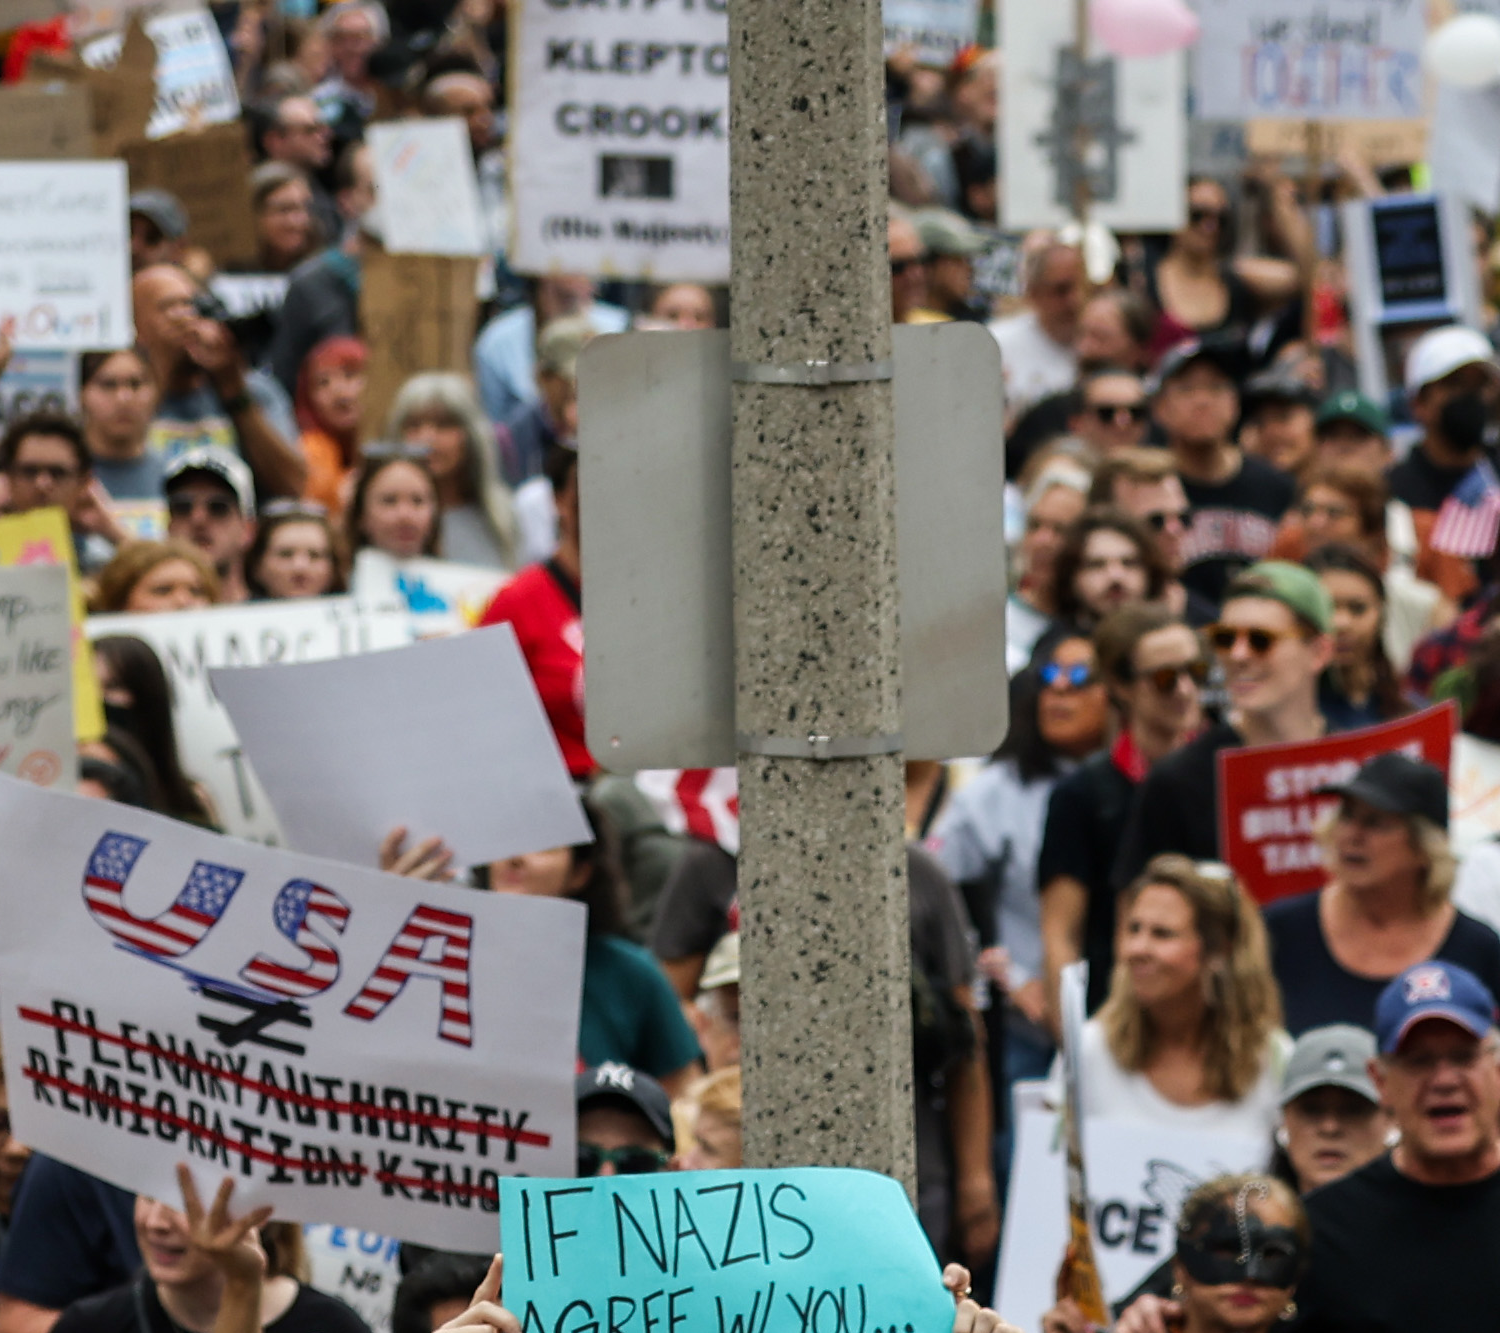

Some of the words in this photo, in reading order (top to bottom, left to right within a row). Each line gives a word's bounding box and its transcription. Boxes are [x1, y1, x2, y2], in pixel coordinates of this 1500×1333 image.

[13, 642, 64, 680] like
[81, 831, 476, 1048] USA
[48, 998, 250, 1108] PLENARY
[256, 1058, 532, 1165] AUTHORITY
[376, 1148, 525, 1212] KING
[518, 1180, 584, 1284] IF
[611, 1180, 818, 1280] NAZIS
